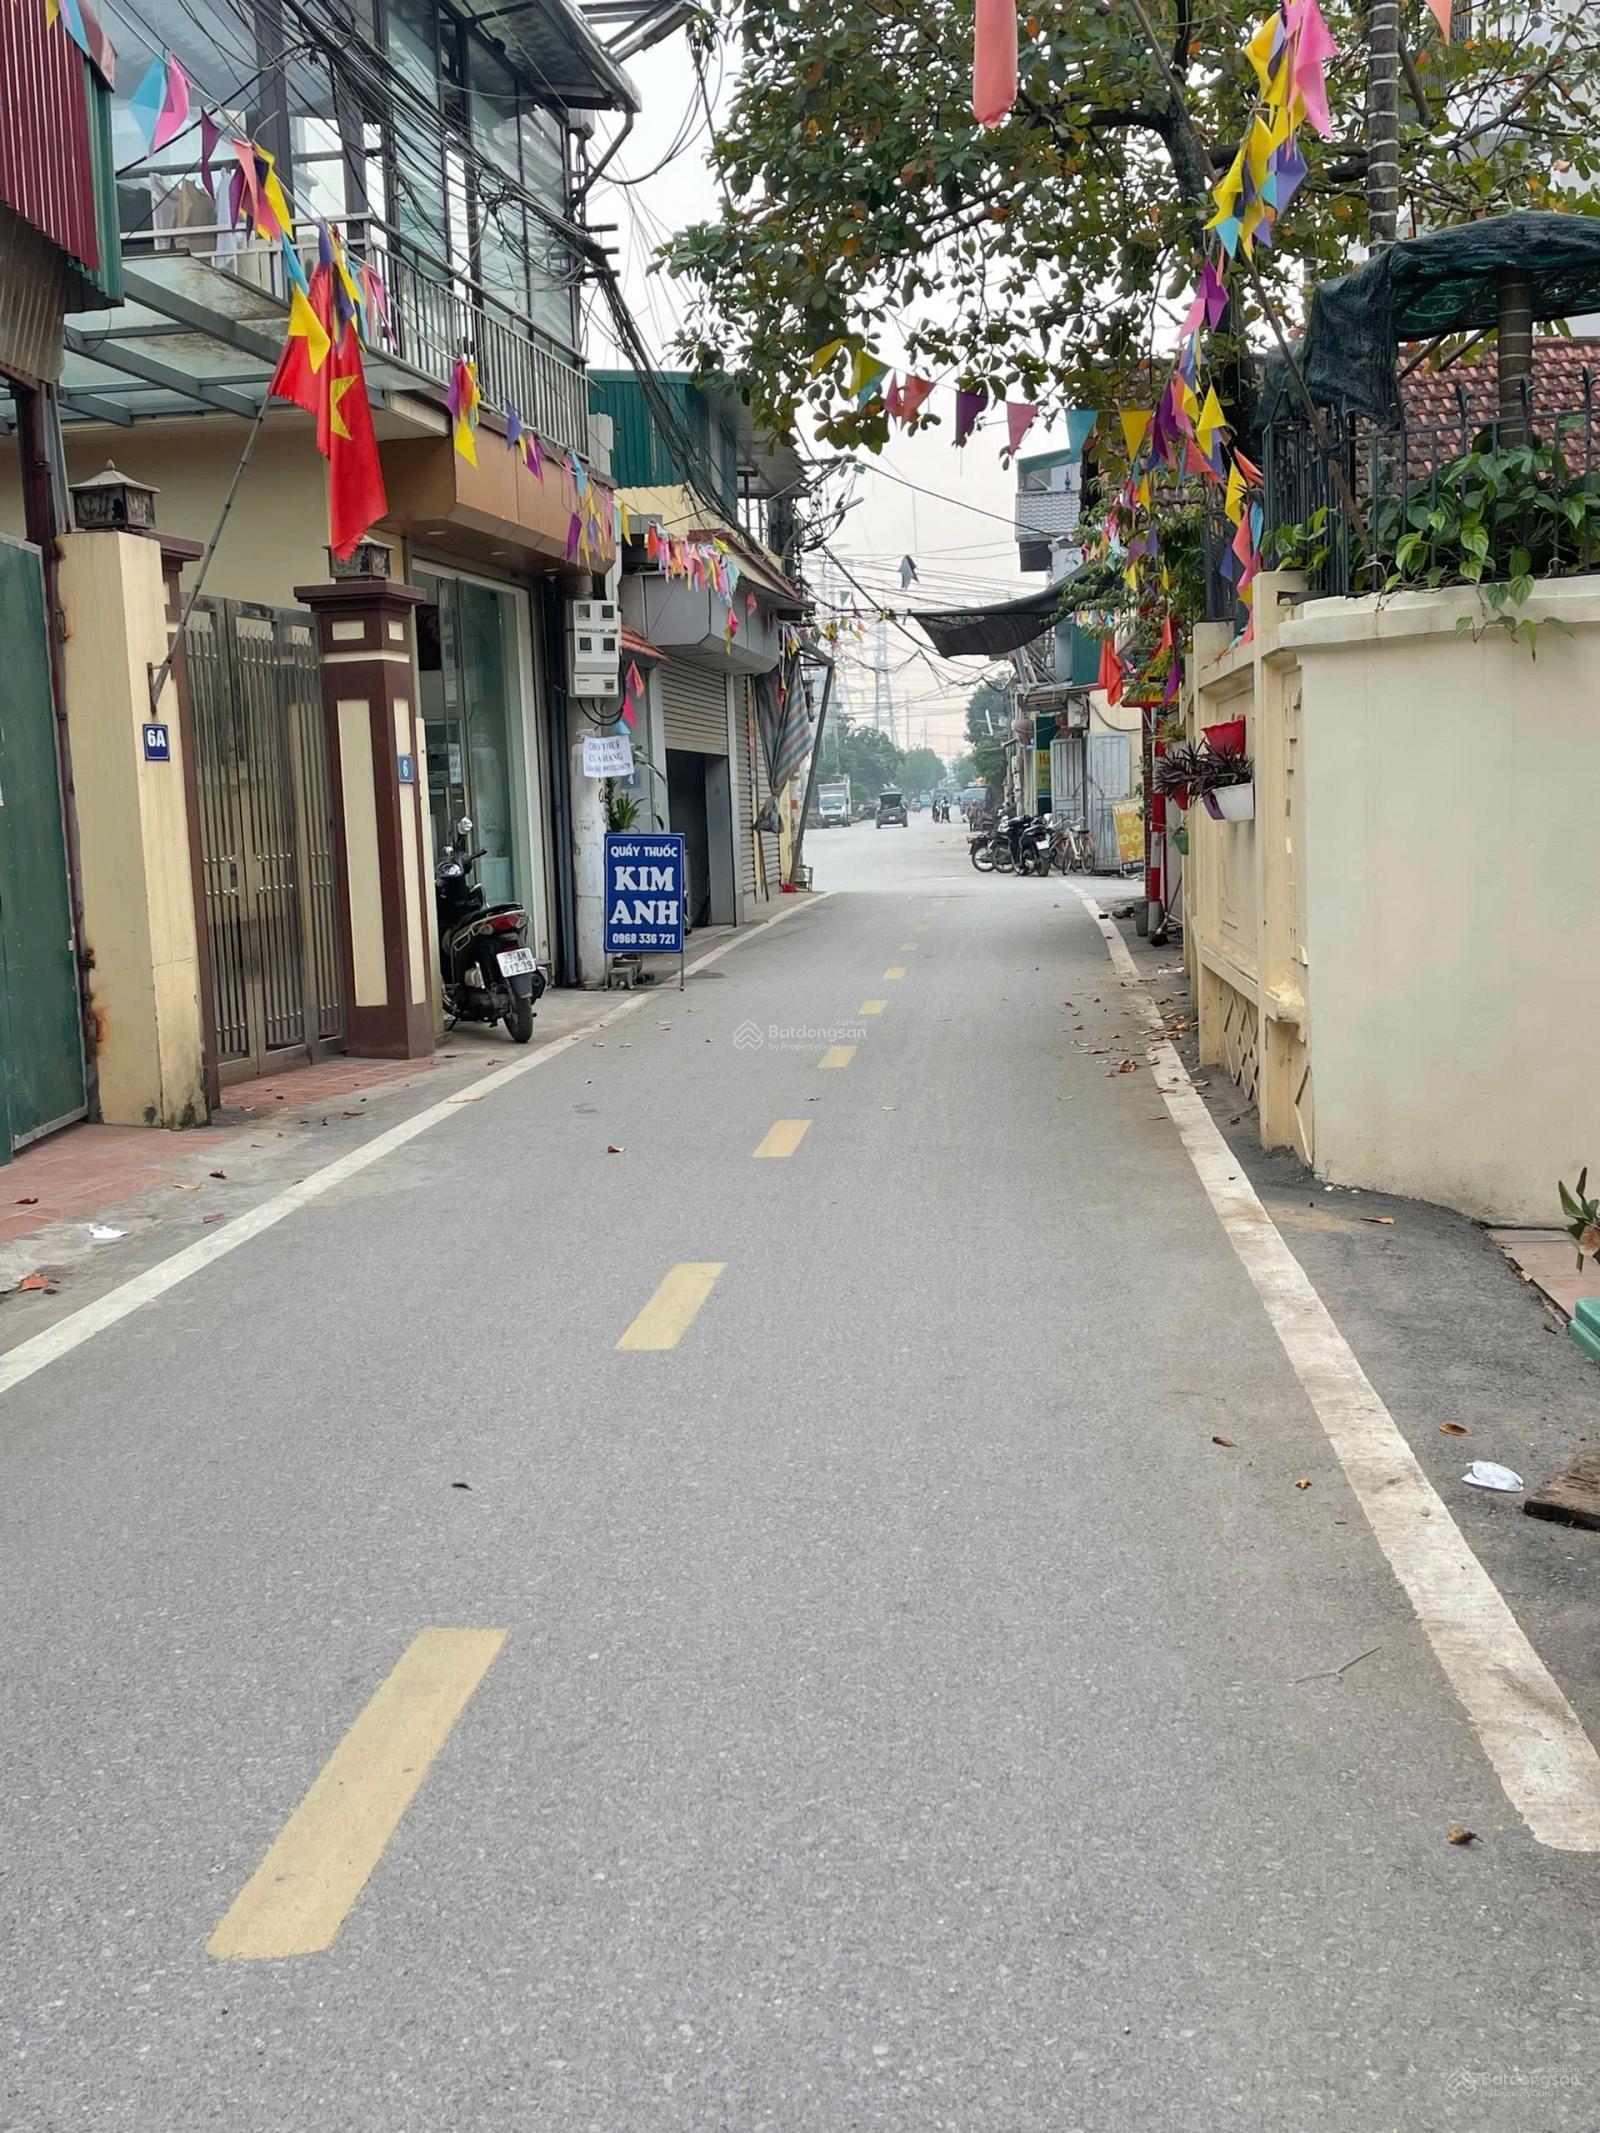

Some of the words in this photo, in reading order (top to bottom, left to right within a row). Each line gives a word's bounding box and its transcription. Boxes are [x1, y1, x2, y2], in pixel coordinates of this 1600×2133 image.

[147, 729, 166, 747] 6A
[402, 759, 409, 778] 6
[614, 866, 674, 891] KIM
[609, 899, 679, 925] ANH
[612, 932, 637, 944] 0968
[659, 934, 676, 945] 721
